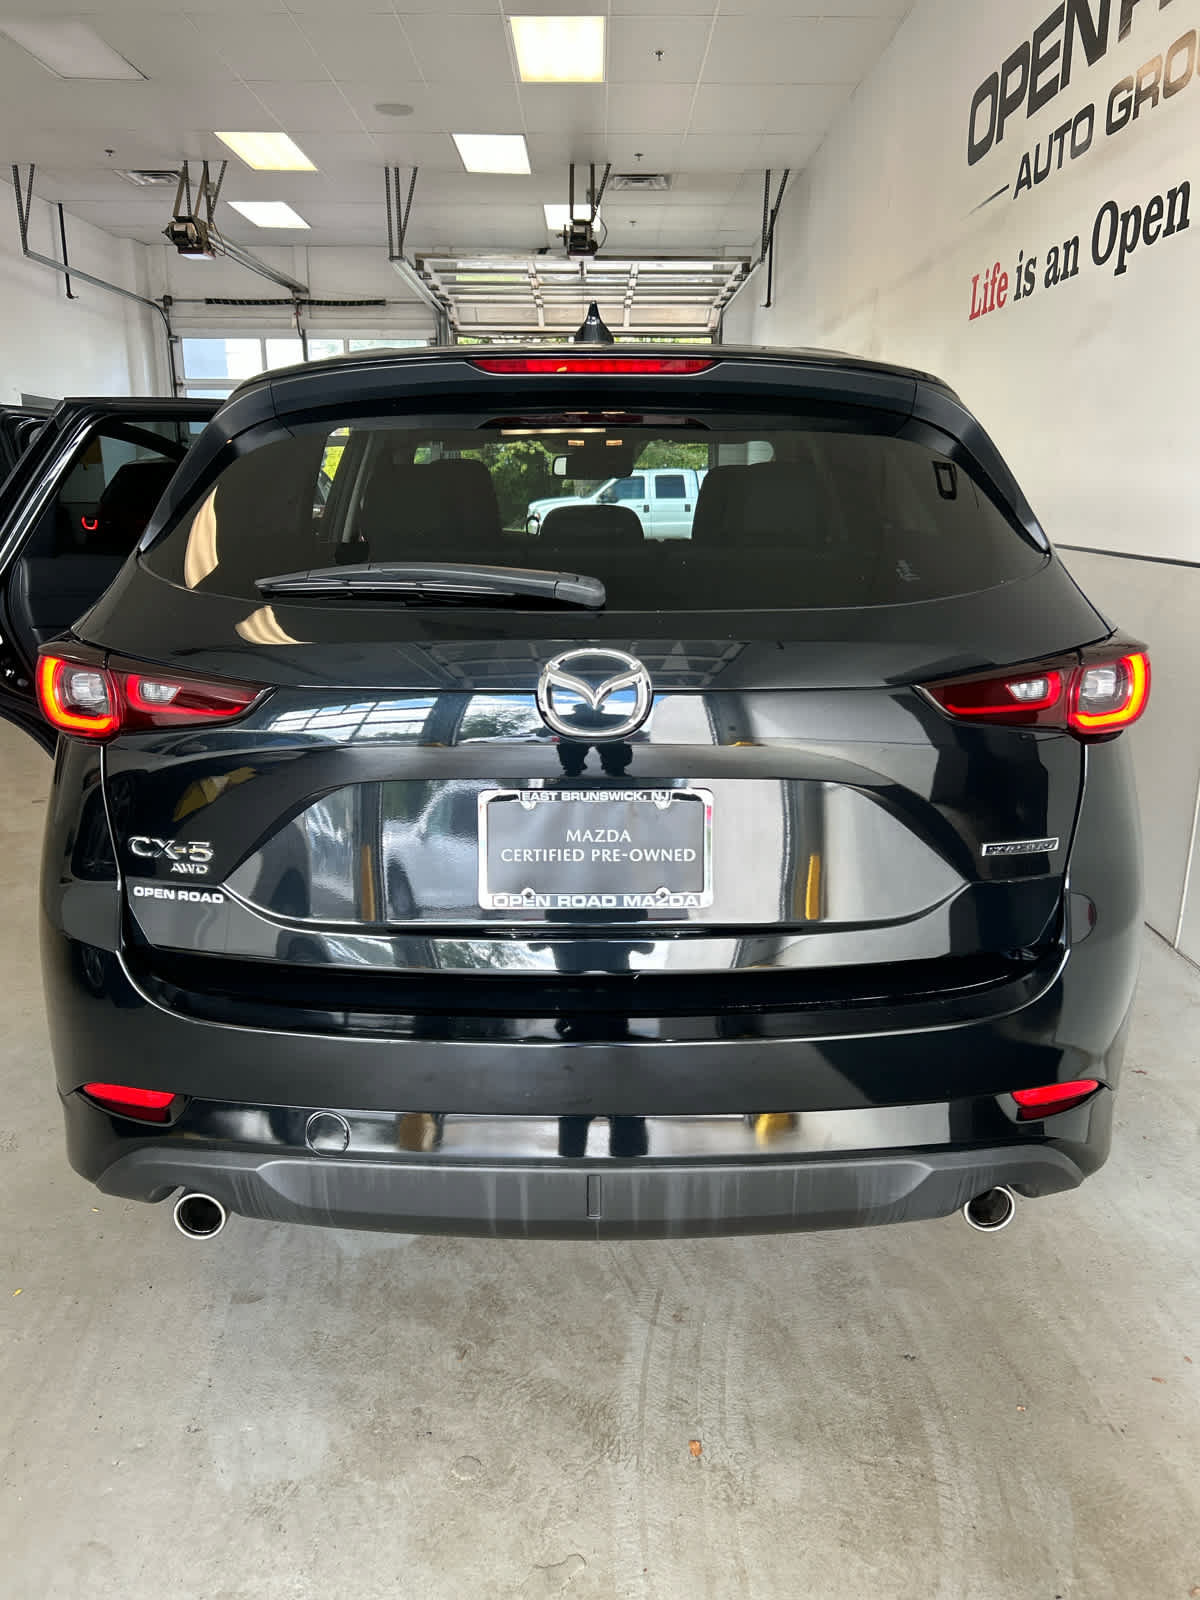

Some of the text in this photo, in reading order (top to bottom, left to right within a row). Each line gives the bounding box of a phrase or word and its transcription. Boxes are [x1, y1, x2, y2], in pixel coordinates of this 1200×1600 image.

[967, 0, 1111, 166] OPEN
[1013, 29, 1200, 200] AUTO GRO
[968, 180, 1191, 321] Life is an Open
[521, 791, 670, 801] EAST BRUNSWICK, NJ
[566, 829, 632, 843] MAZDA
[128, 836, 214, 862] CX-5
[500, 848, 697, 862] CERTIFIED PRE-OWNED
[170, 862, 209, 875] AWD
[133, 886, 225, 904] OPEN ROAD
[493, 895, 701, 908] OPEN ROAD MAZDA
